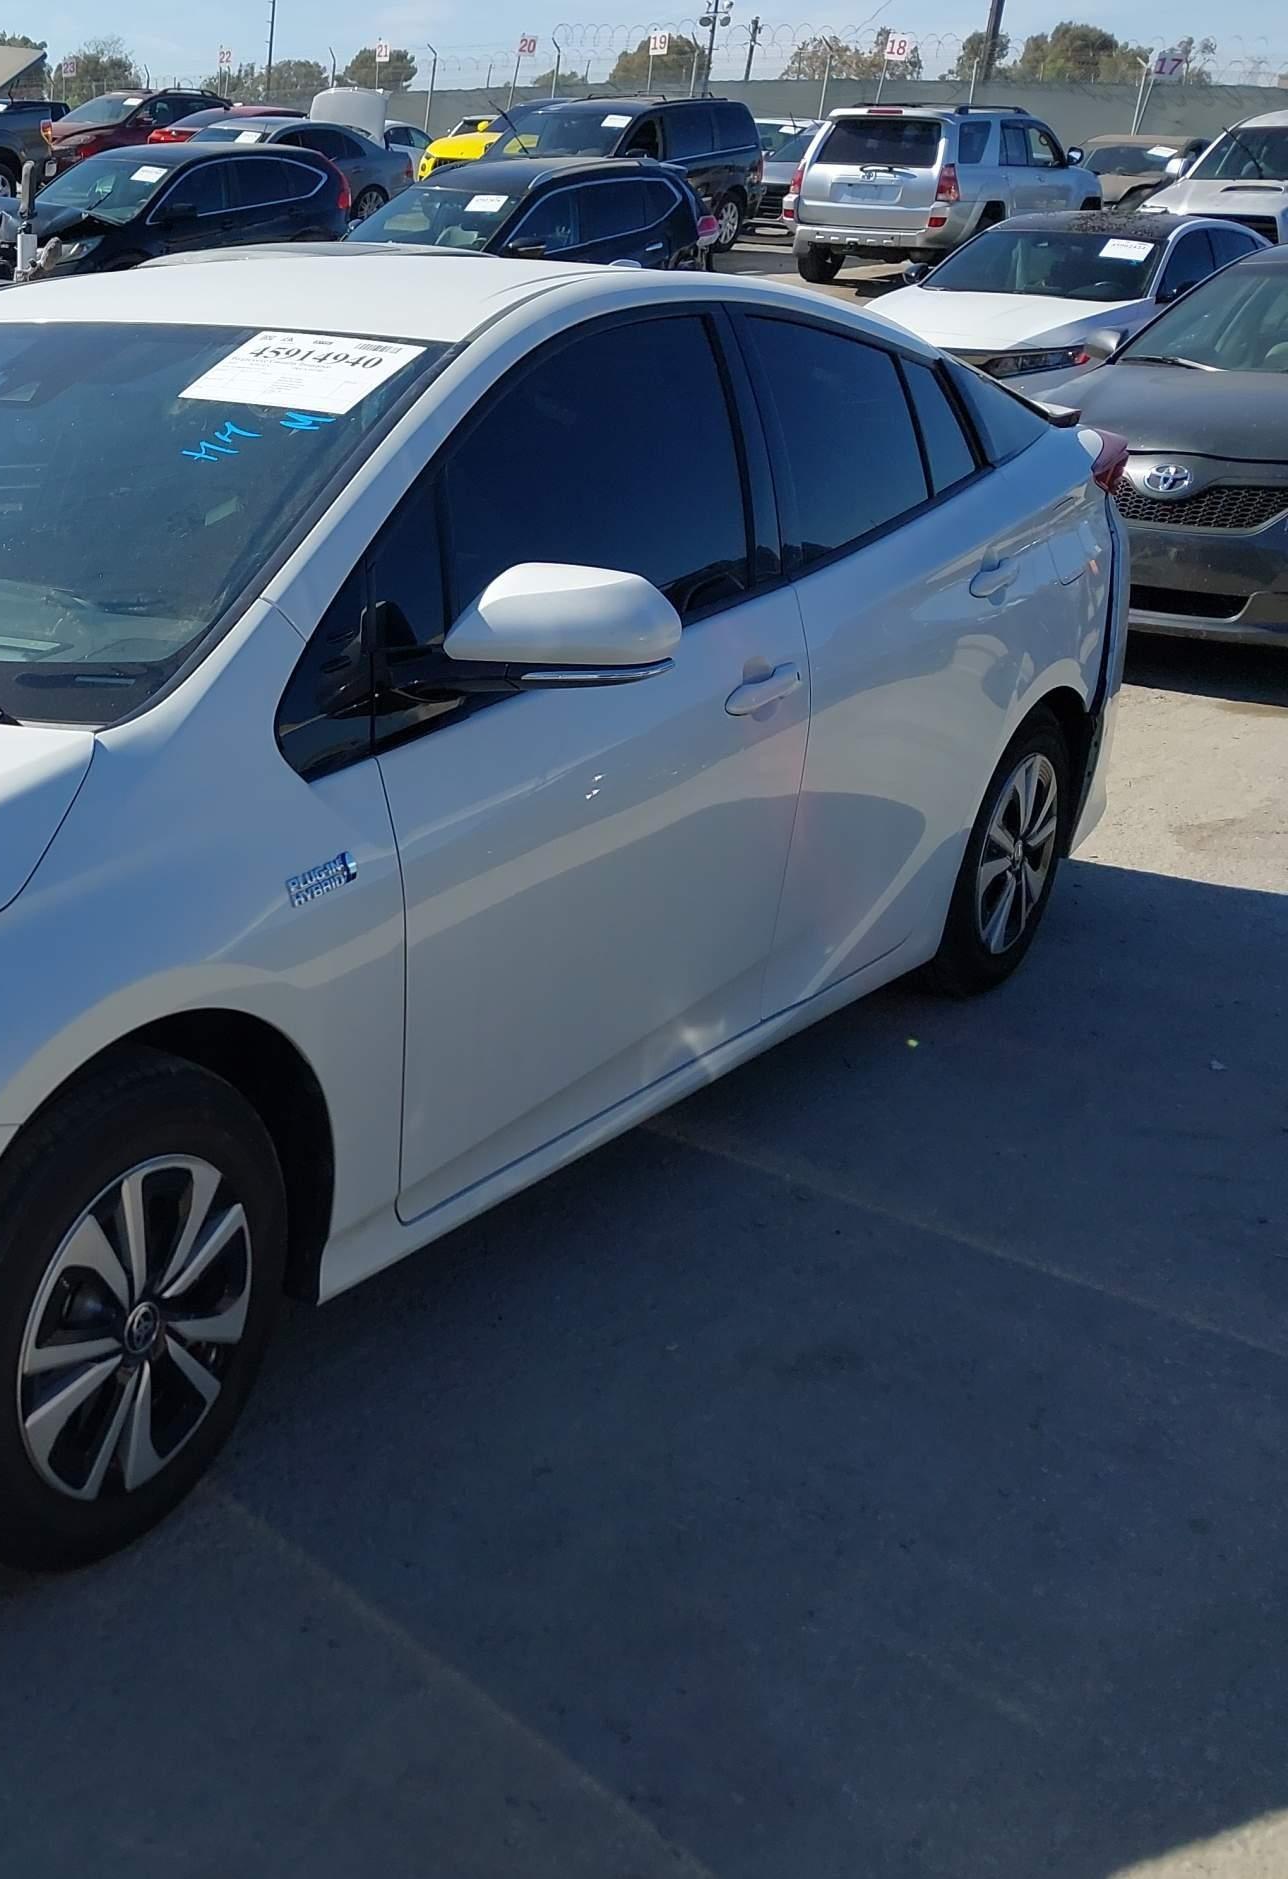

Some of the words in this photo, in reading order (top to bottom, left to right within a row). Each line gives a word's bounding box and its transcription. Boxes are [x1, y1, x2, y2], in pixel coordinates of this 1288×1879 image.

[519, 38, 536, 53] 20
[651, 35, 667, 50] 19
[887, 39, 907, 55] 18
[219, 51, 232, 63] 22
[377, 44, 389, 57] 21
[1154, 58, 1183, 75] 17
[249, 344, 383, 369] 45914940
[293, 875, 346, 907] HYBRID
